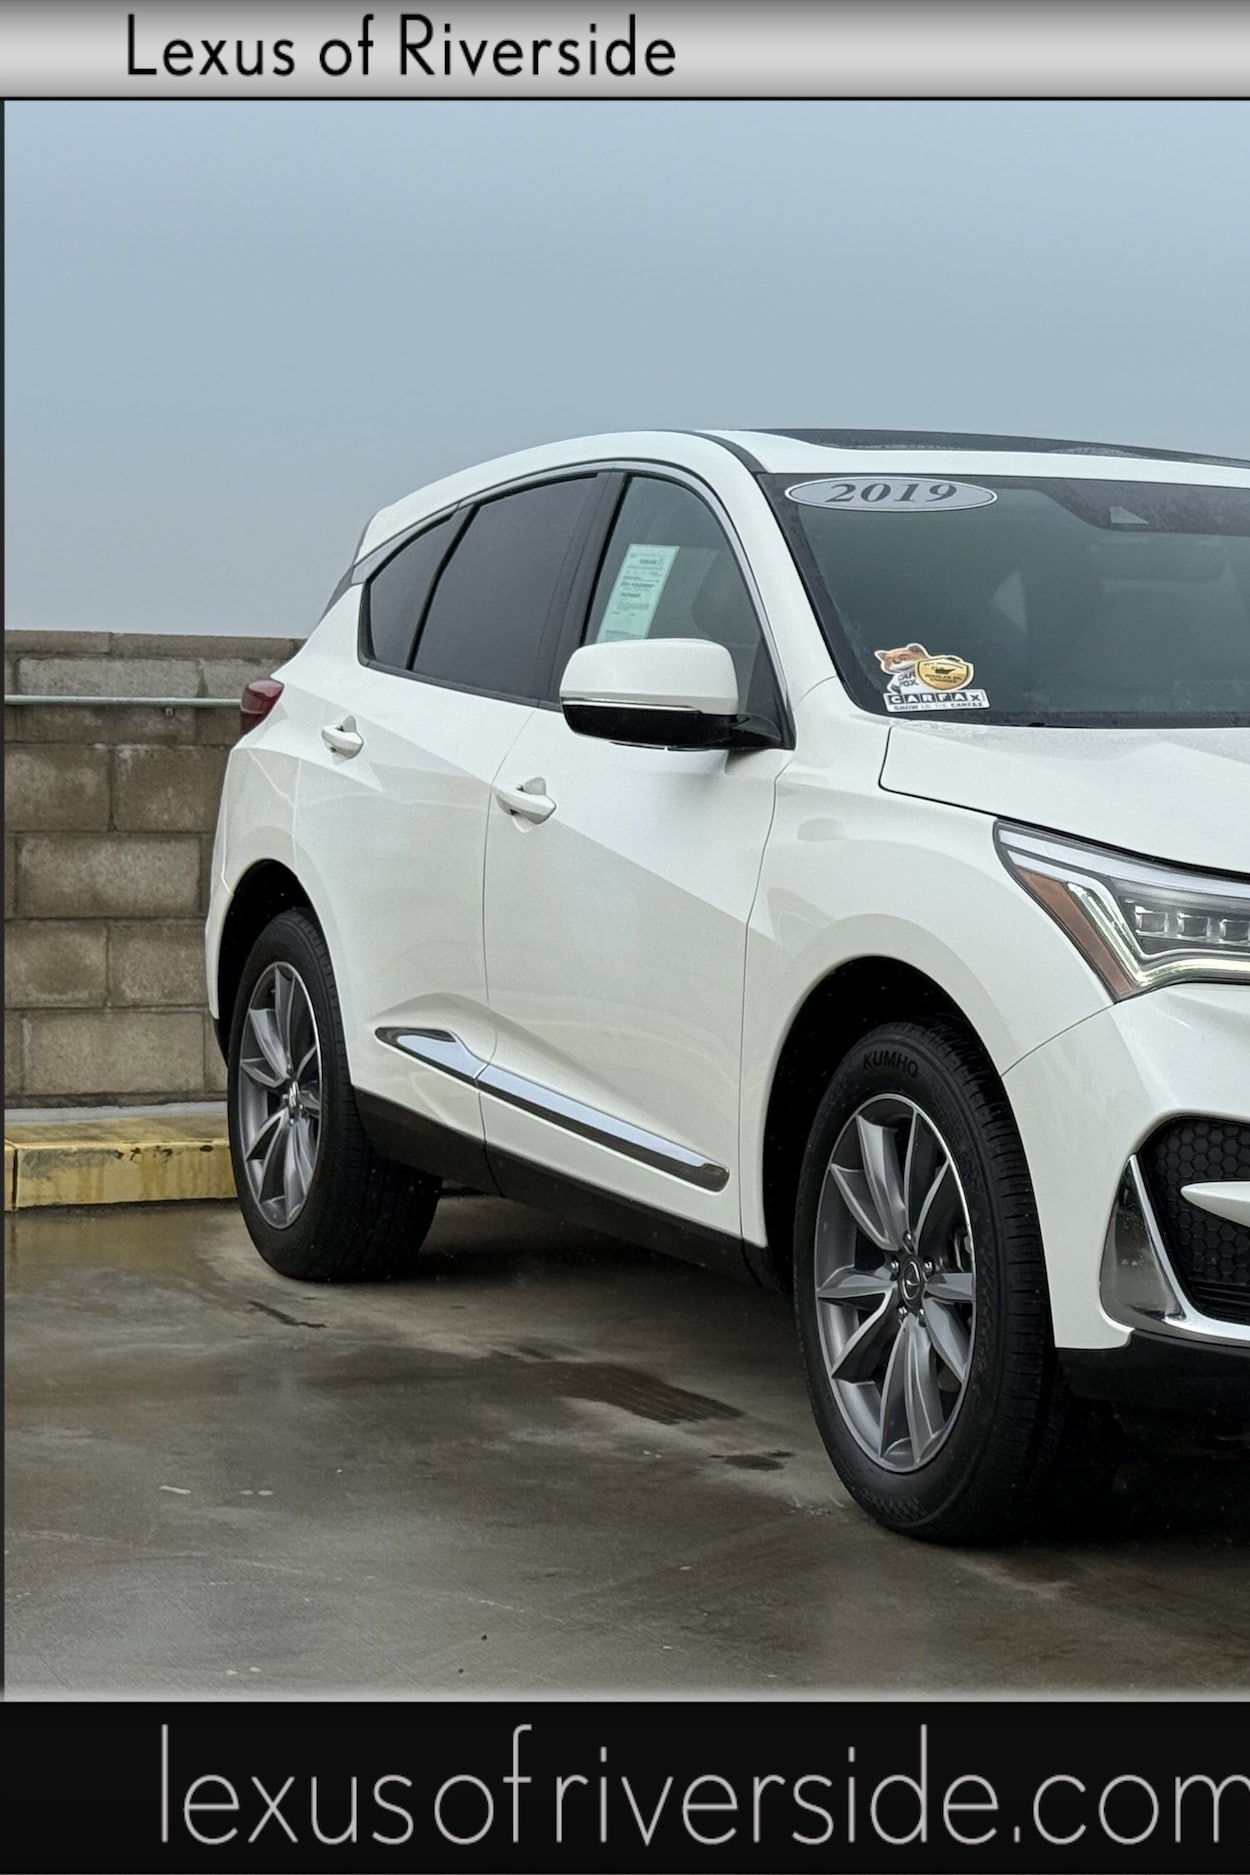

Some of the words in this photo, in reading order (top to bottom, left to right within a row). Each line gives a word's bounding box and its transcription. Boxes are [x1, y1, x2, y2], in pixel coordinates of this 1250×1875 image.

[825, 482, 958, 503] 2019
[889, 692, 981, 705] CARFAX
[863, 1050, 919, 1078] KUMHO
